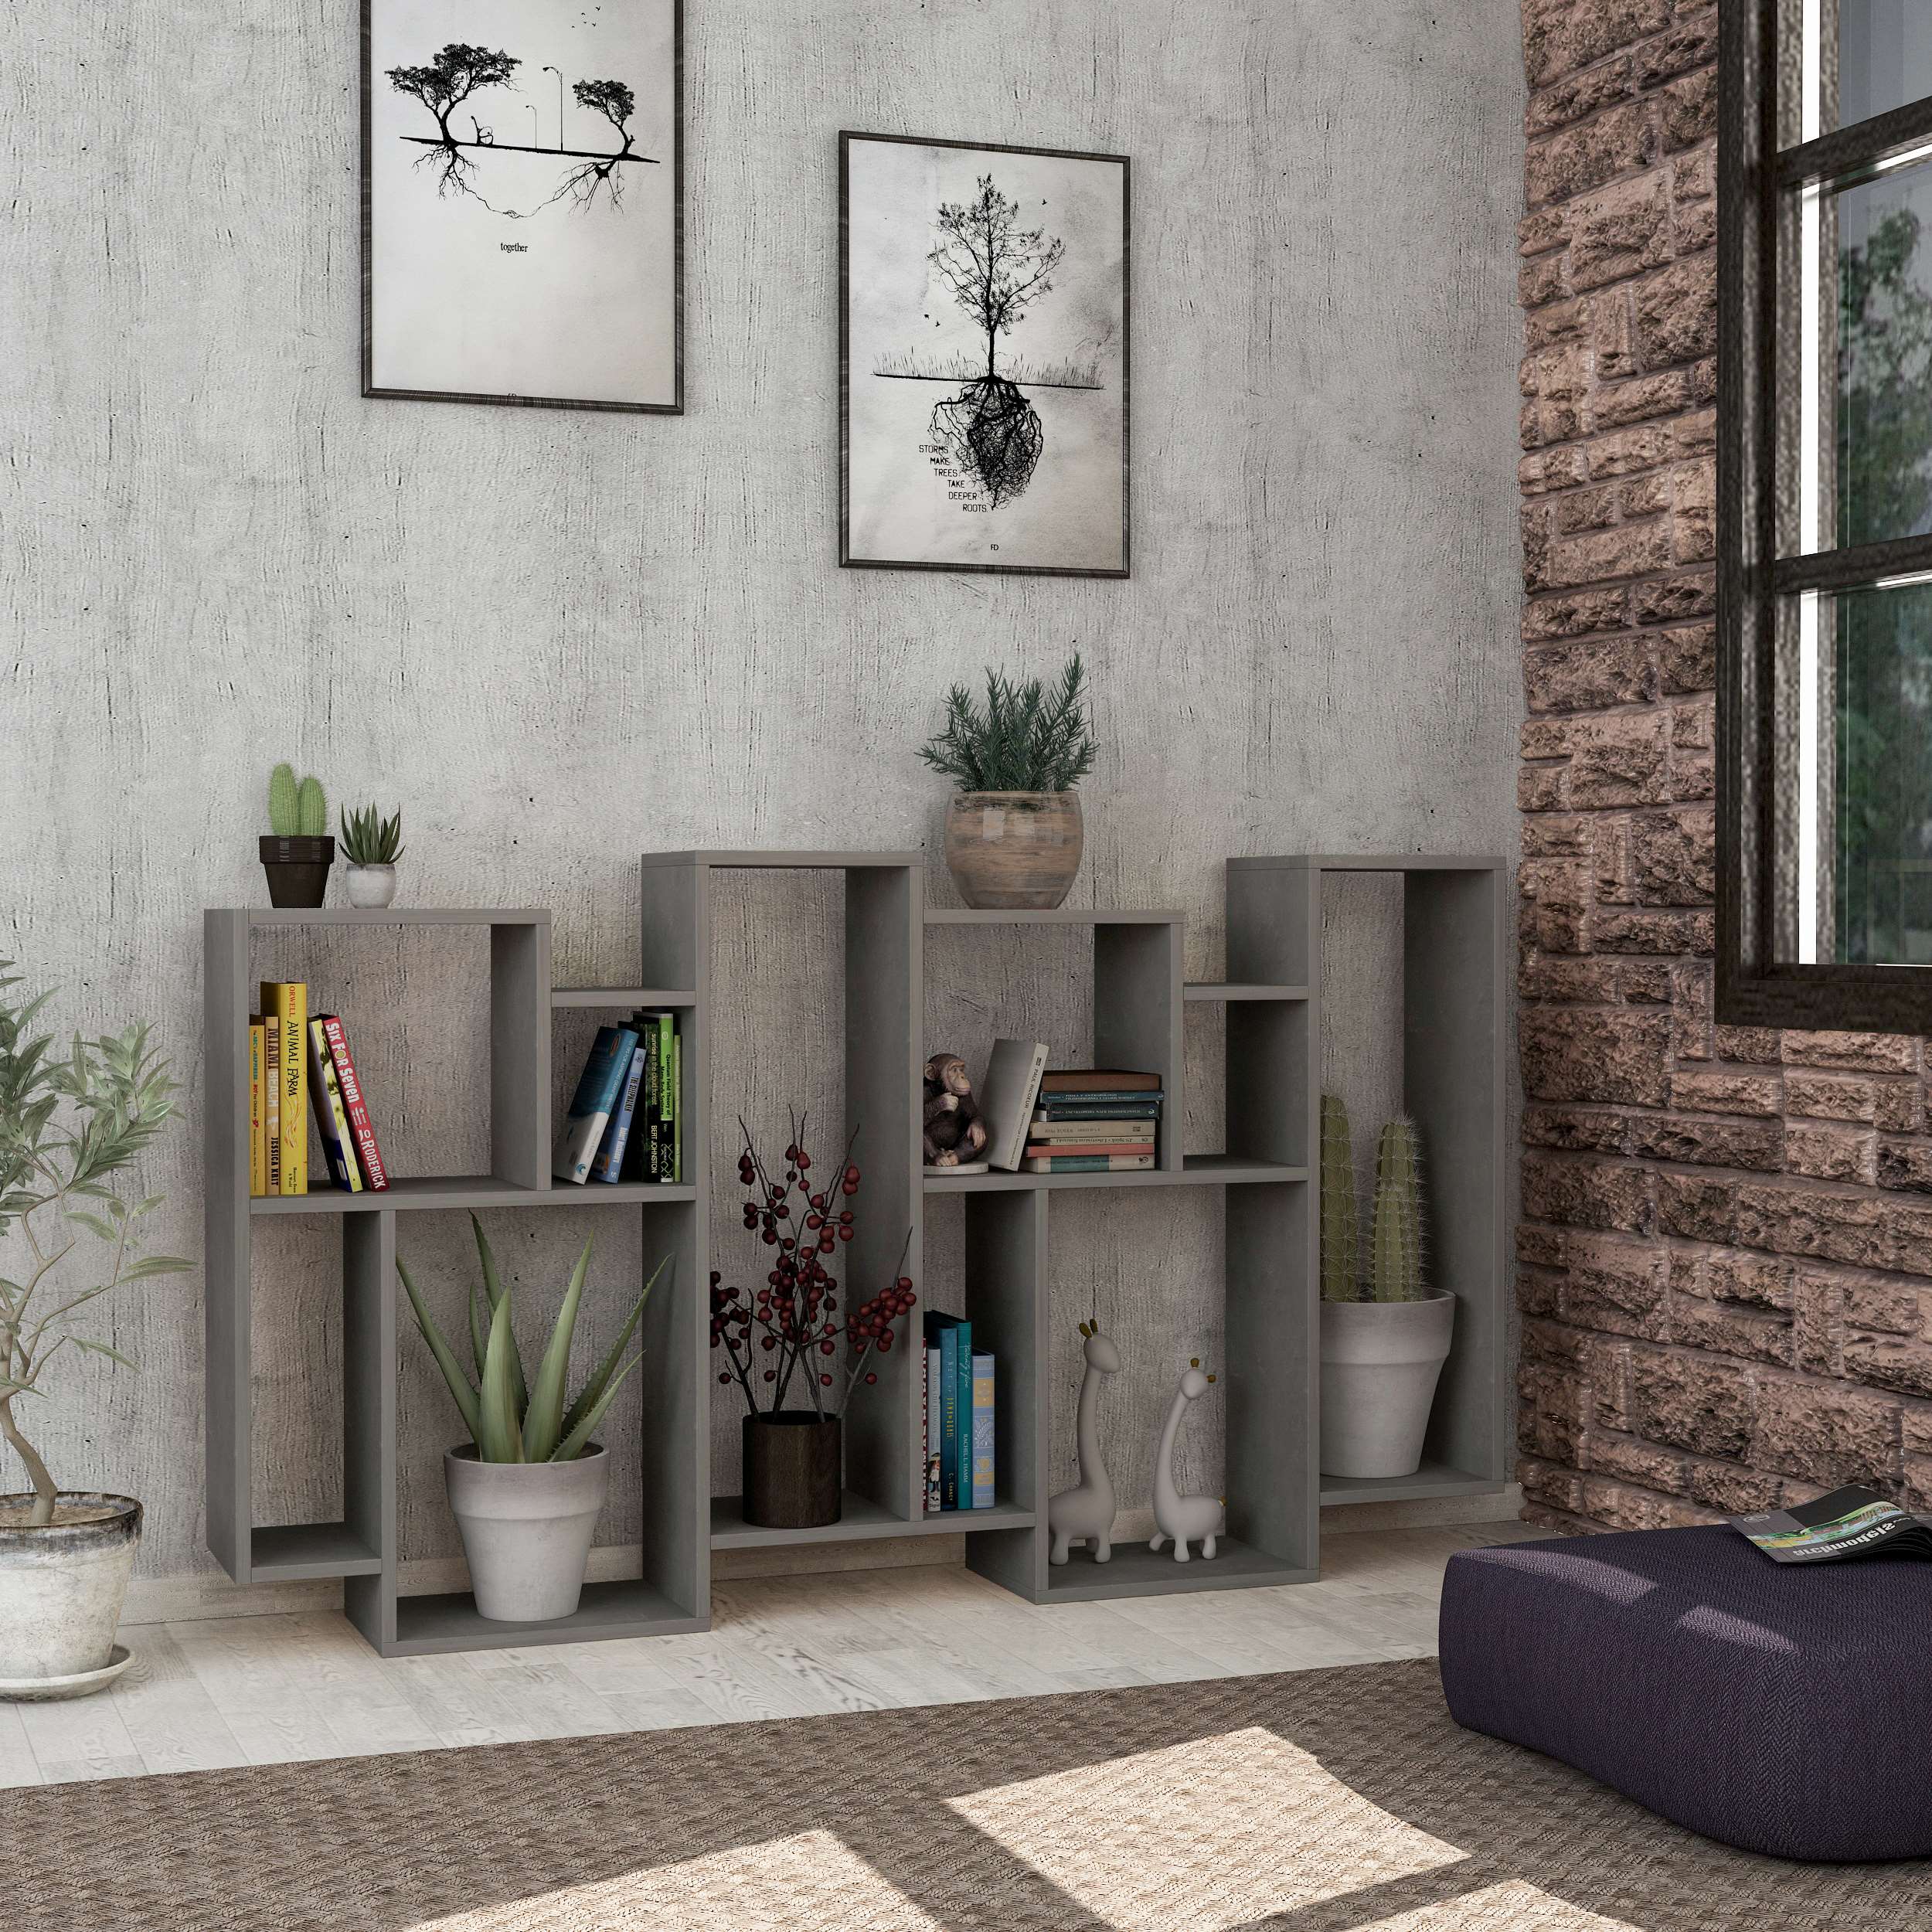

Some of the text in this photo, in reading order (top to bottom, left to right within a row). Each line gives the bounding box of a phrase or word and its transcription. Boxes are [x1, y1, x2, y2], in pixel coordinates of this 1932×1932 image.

[501, 242, 529, 253] together
[919, 444, 949, 454] STORMS
[930, 457, 951, 465] MAKE
[934, 468, 958, 477] TREES
[948, 492, 978, 500] DEEPER
[962, 504, 987, 512] ROOTS
[325, 1022, 342, 1043] SIX
[287, 1020, 298, 1097] ANIMAL FARM
[267, 1029, 278, 1107] MIAMI BEACH
[360, 1140, 386, 1189] RODERICK
